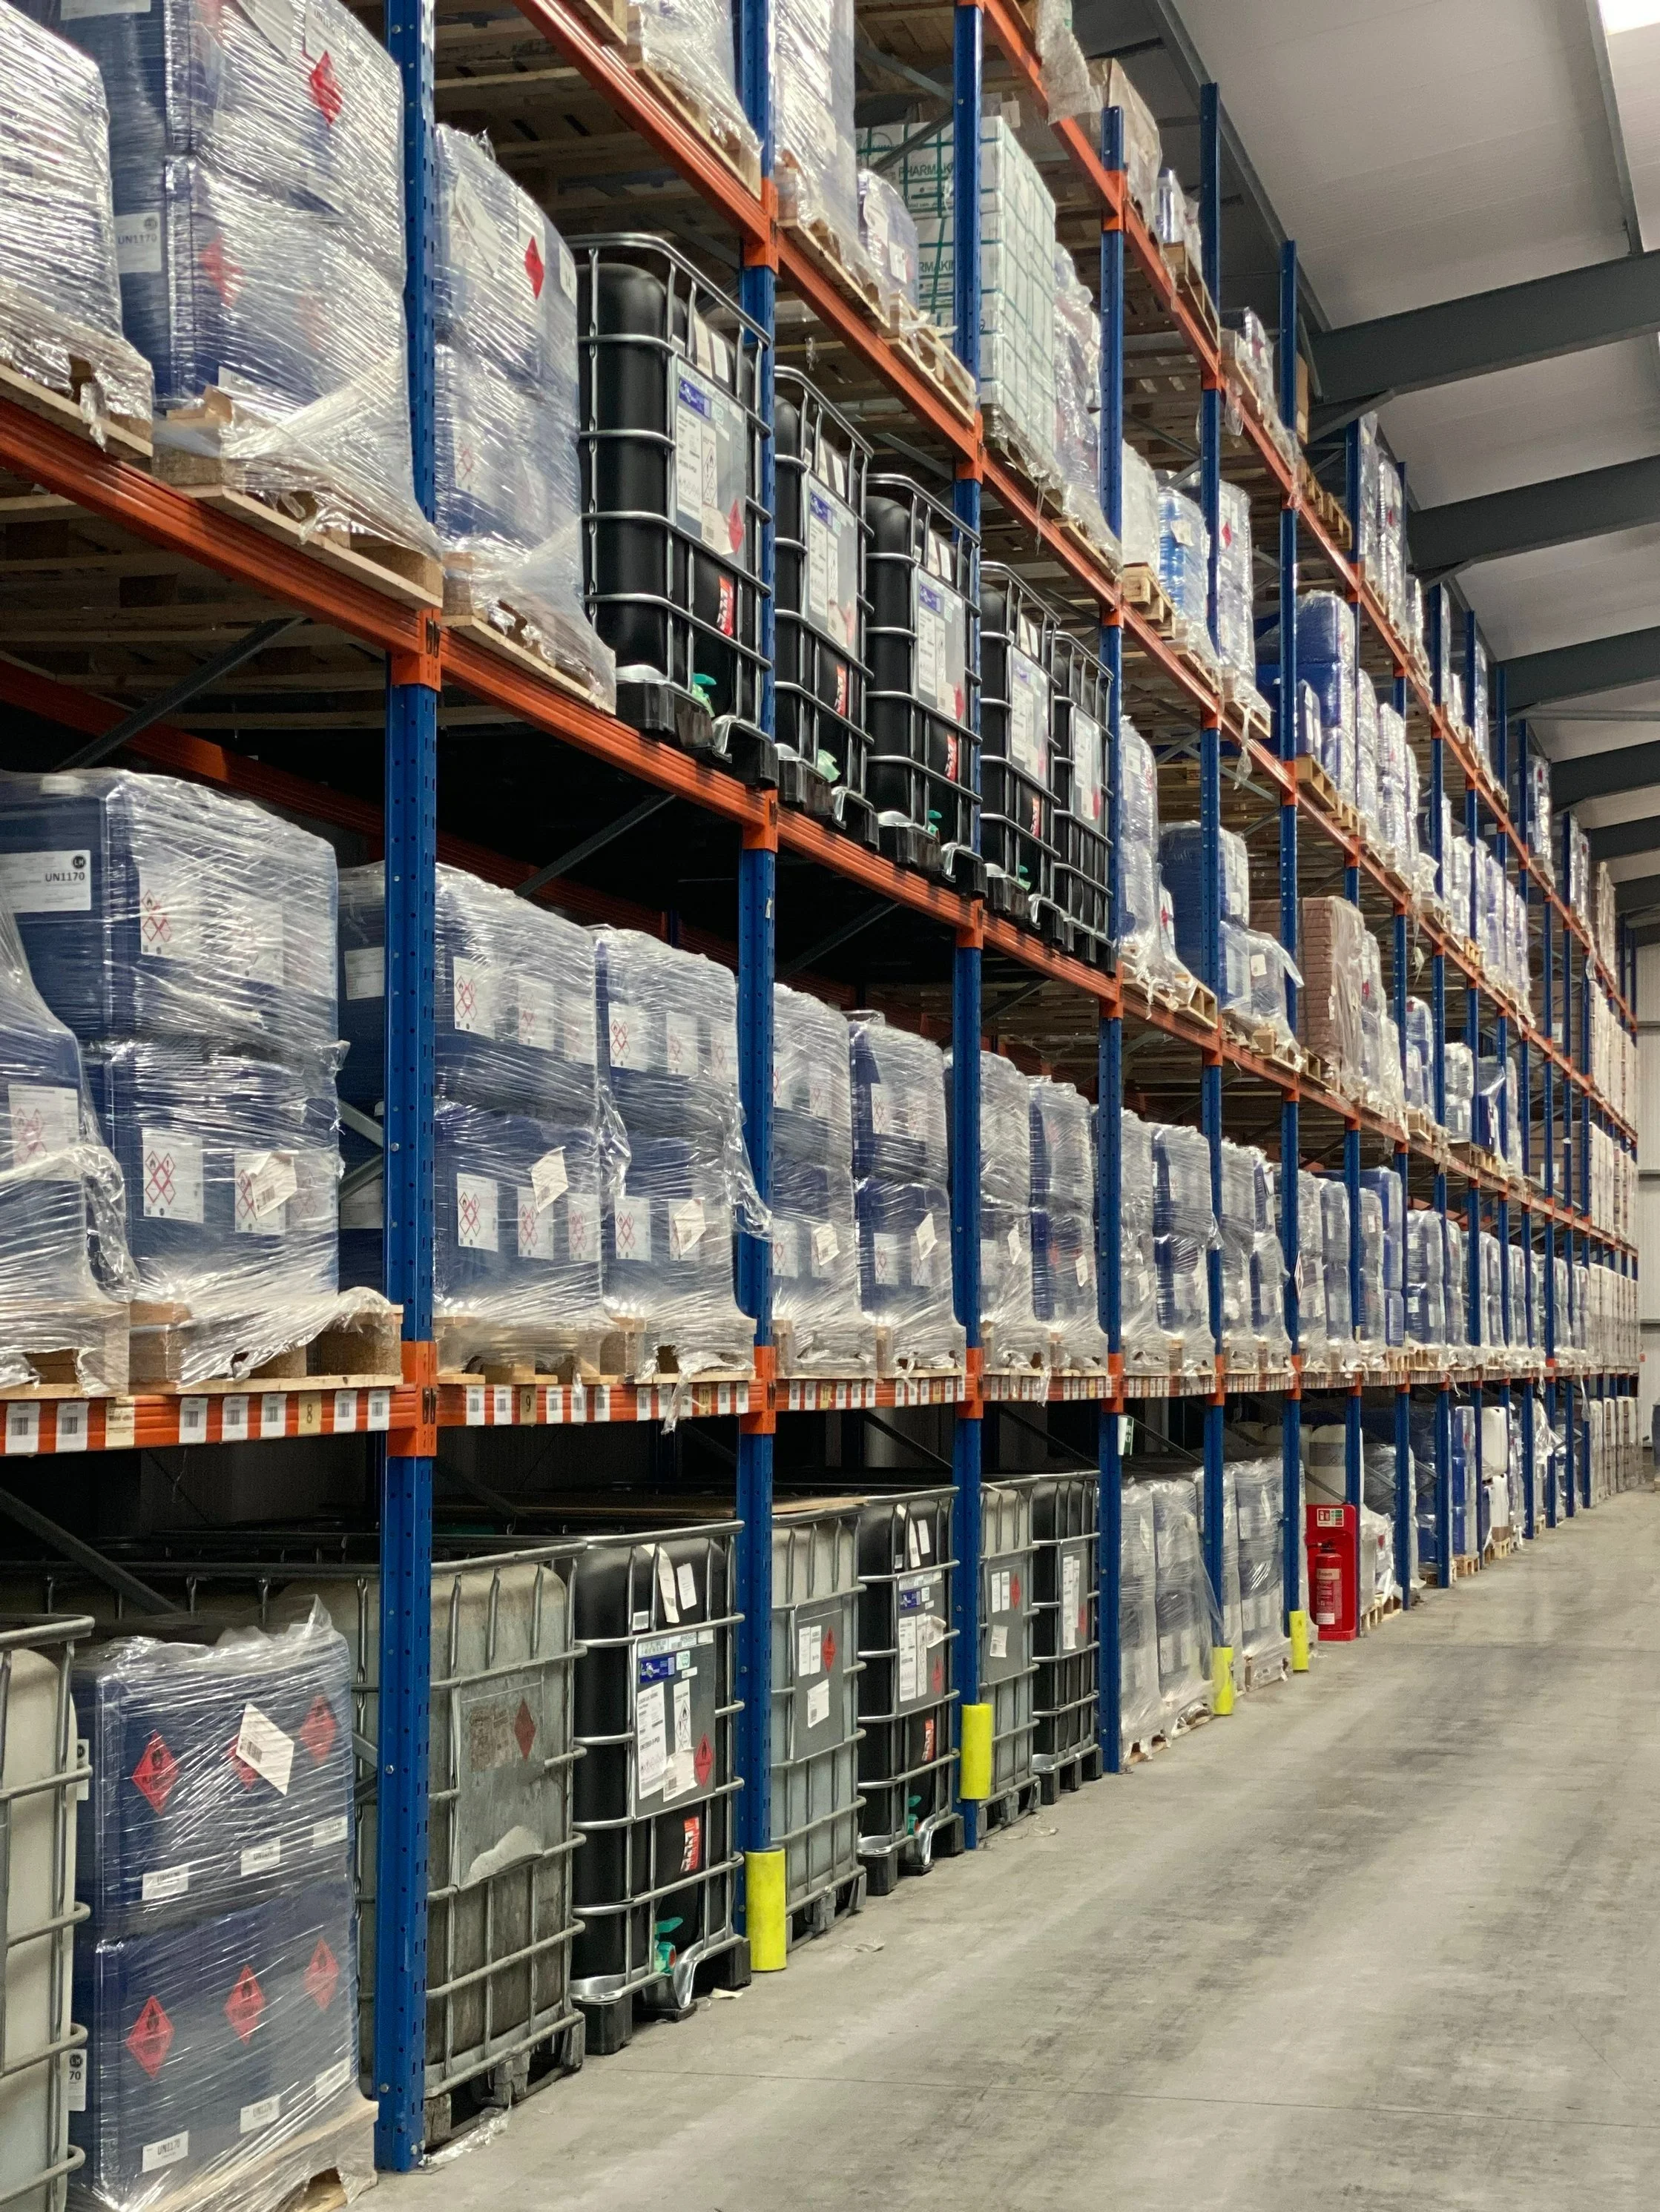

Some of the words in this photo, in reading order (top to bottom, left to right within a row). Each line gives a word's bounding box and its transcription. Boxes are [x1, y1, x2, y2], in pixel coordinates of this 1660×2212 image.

[118, 234, 157, 244] UN1170
[45, 872, 85, 882] UN1170
[525, 1395, 532, 1413] 9
[306, 1403, 313, 1424] 8
[70, 2071, 81, 2080] 70
[157, 2139, 180, 2156] UN1170
